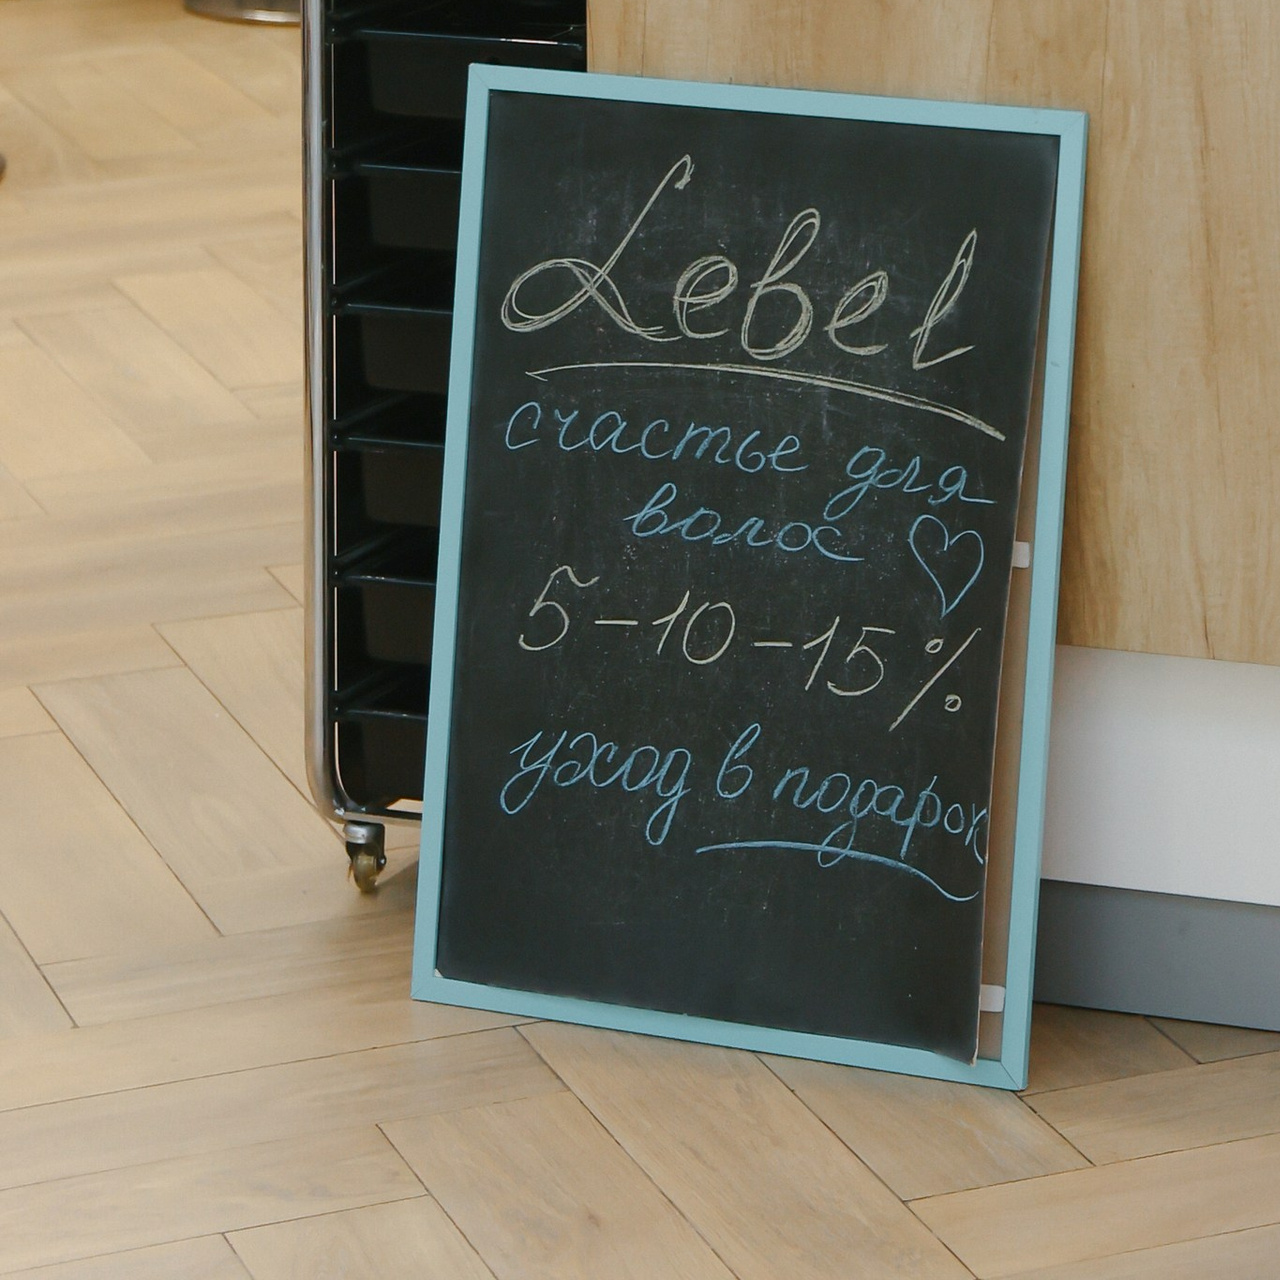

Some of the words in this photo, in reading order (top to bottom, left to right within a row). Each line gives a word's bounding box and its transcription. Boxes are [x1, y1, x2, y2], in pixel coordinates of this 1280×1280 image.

[500, 153, 978, 371] Lebel
[503, 401, 809, 472] счастье
[824, 443, 998, 521] для
[625, 481, 865, 563] волос
[498, 724, 692, 846] уход
[715, 721, 754, 796] в
[771, 771, 988, 867] подарок
